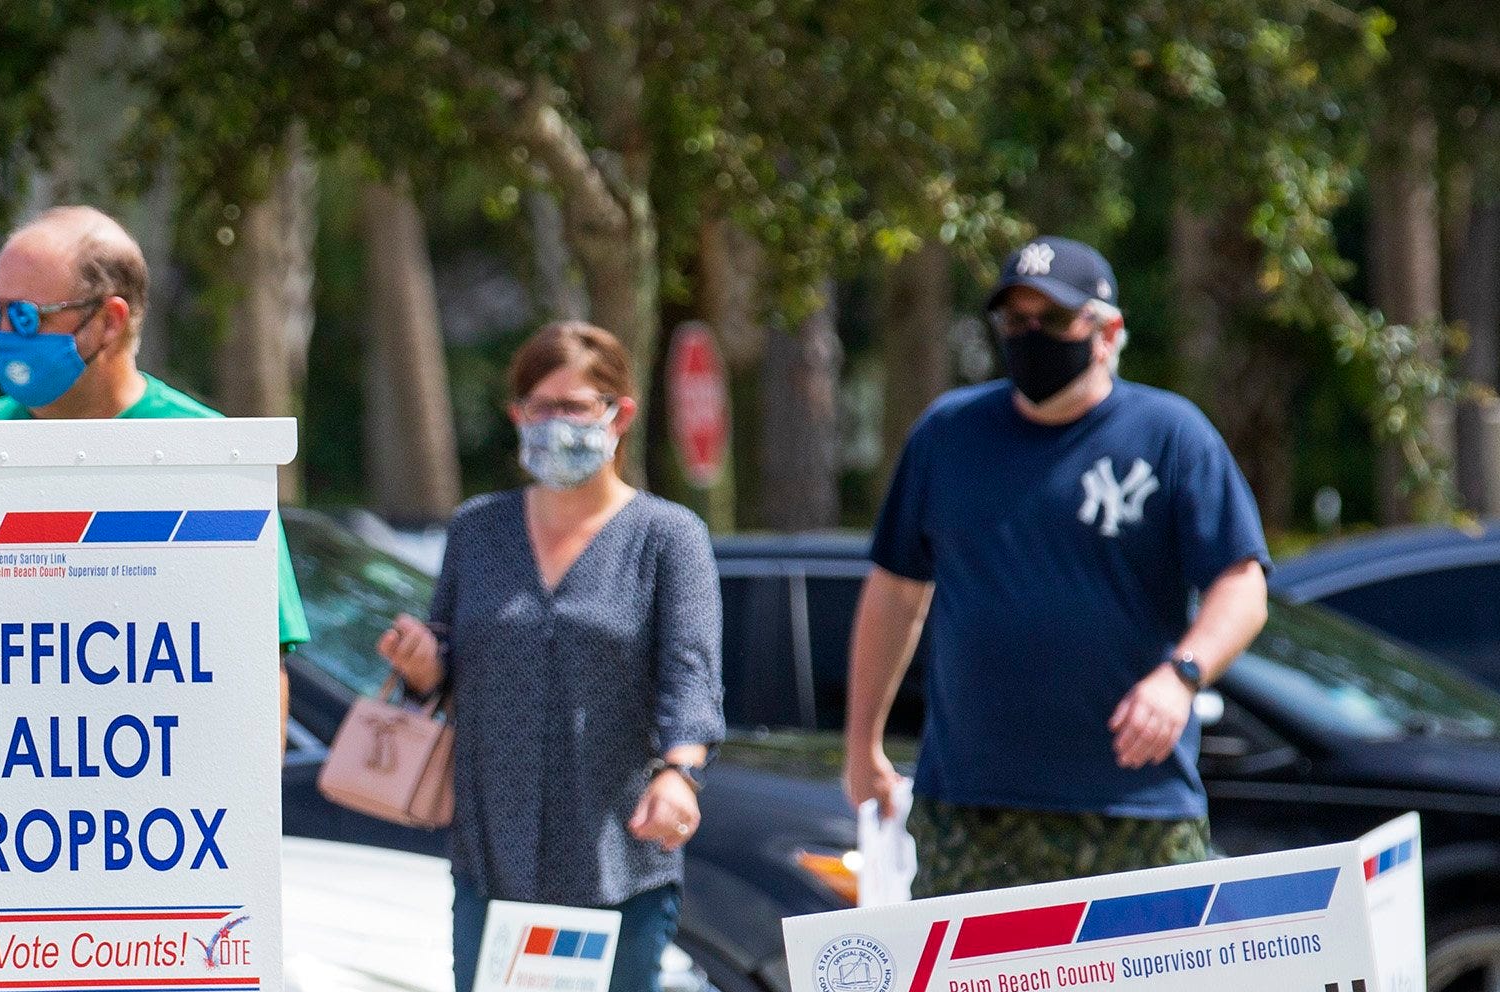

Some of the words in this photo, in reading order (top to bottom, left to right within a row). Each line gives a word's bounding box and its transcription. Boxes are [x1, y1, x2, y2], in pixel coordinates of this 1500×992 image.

[1077, 456, 1160, 537] NY
[13, 566, 37, 577] Beach
[39, 566, 66, 578] County
[68, 565, 109, 578] Supervisor
[111, 565, 119, 576] of
[121, 564, 157, 576] Elections
[20, 553, 48, 566] Sartory
[50, 552, 66, 564] Link
[71, 931, 189, 968] Counts!
[818, 944, 839, 971] STATE
[841, 938, 852, 947] OF
[856, 938, 889, 965] FLORIDA
[833, 950, 857, 966] OFFICIAL
[858, 950, 873, 962] SEAL
[1056, 960, 1116, 988] County
[1121, 947, 1212, 978] Supervisor
[1218, 942, 1236, 966] of
[1242, 932, 1322, 962] Elections
